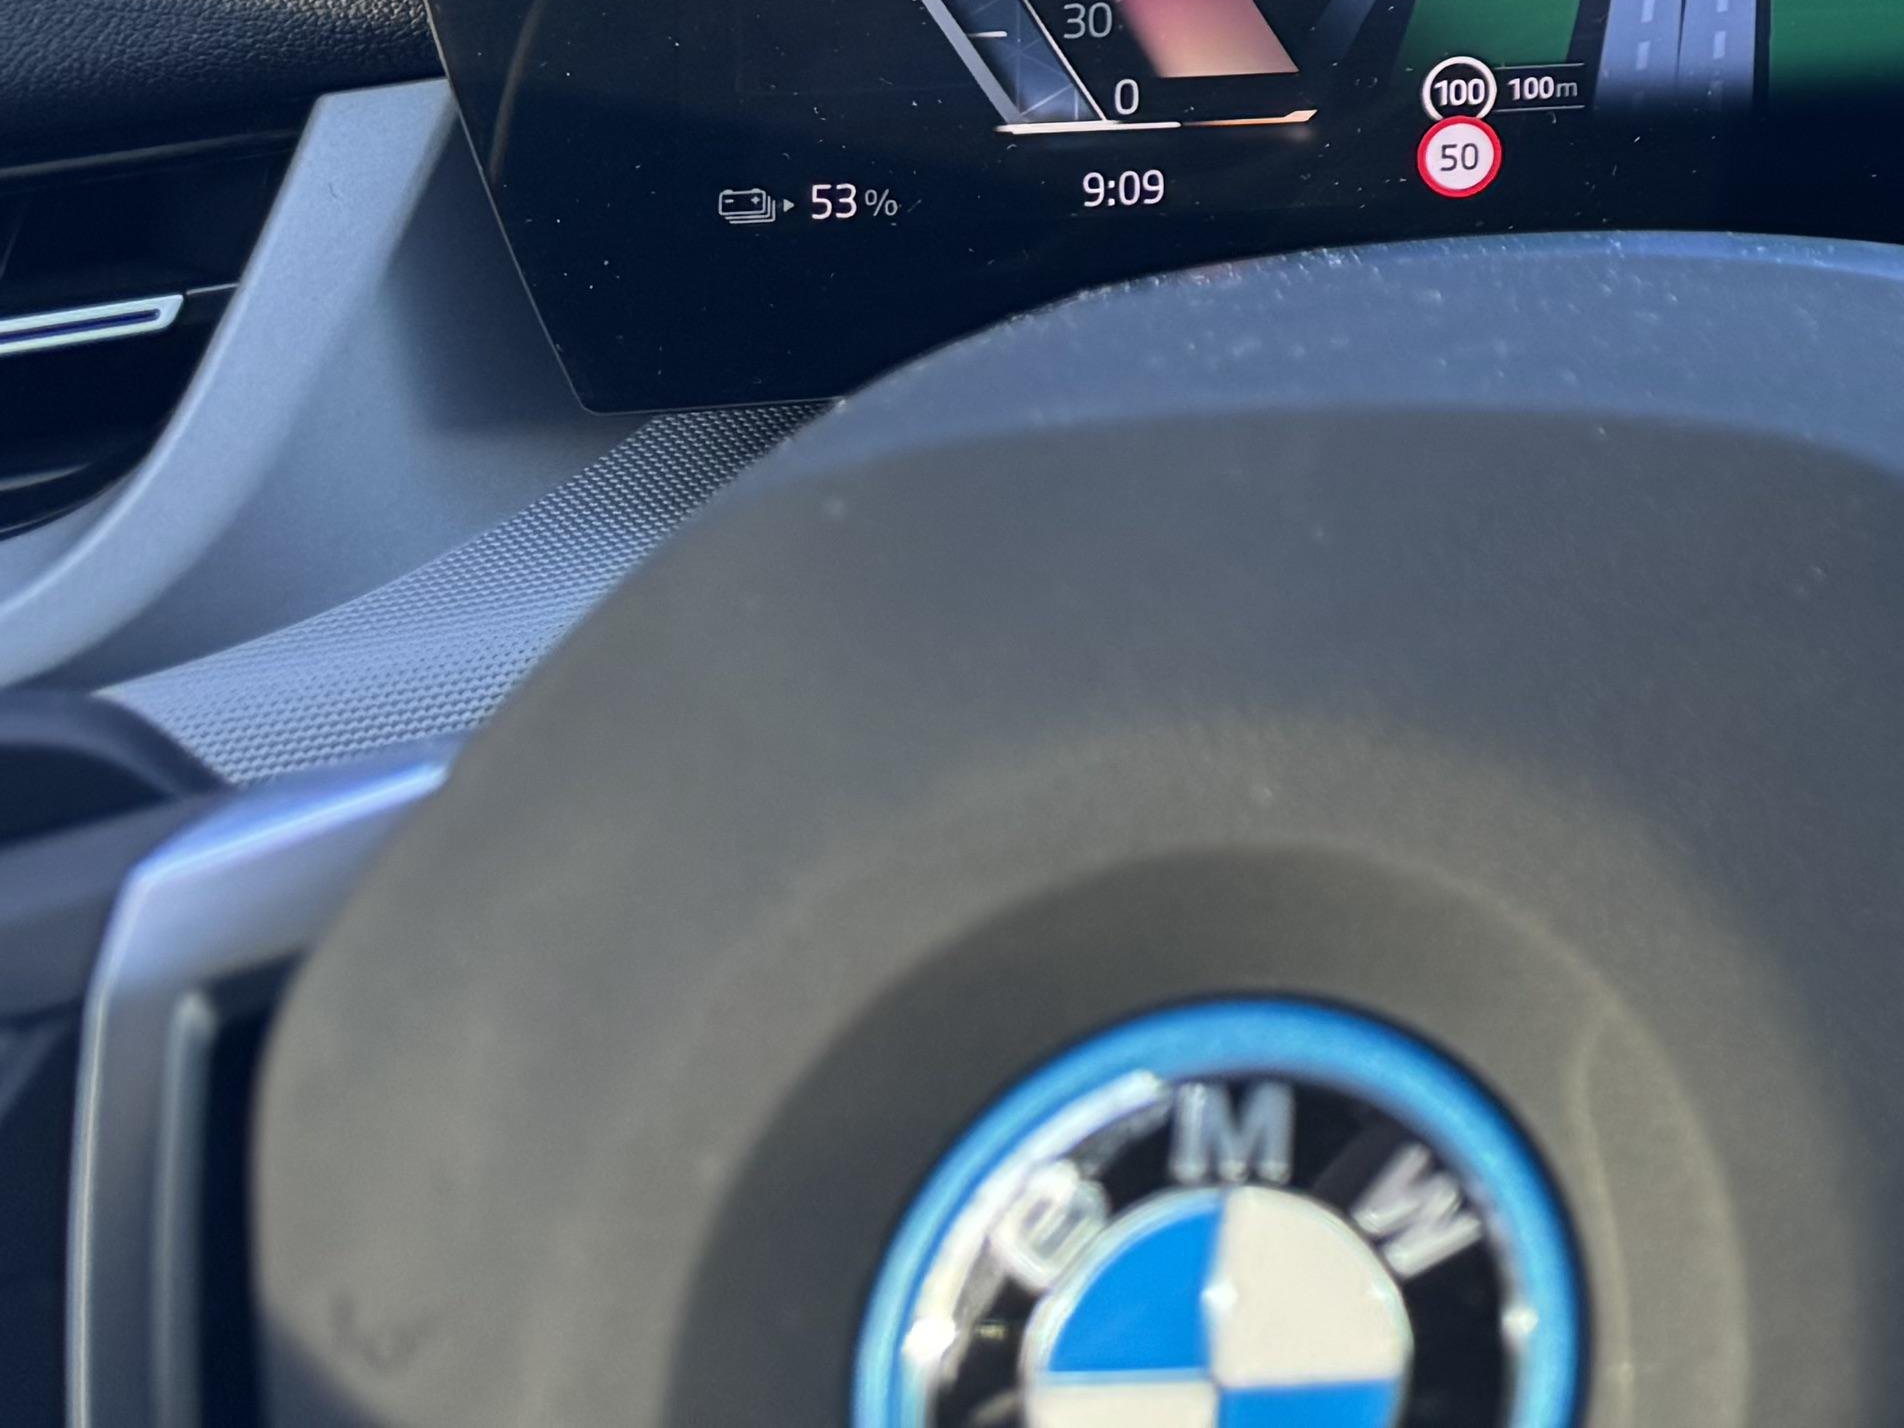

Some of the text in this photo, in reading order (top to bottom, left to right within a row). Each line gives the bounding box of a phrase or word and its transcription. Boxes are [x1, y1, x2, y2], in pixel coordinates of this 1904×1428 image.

[1064, 3, 1113, 38] 30
[1114, 80, 1139, 115] 0
[1434, 78, 1485, 106] 100
[1440, 143, 1479, 171] 50
[810, 185, 898, 218] 53 %
[1082, 170, 1165, 205] 9:09
